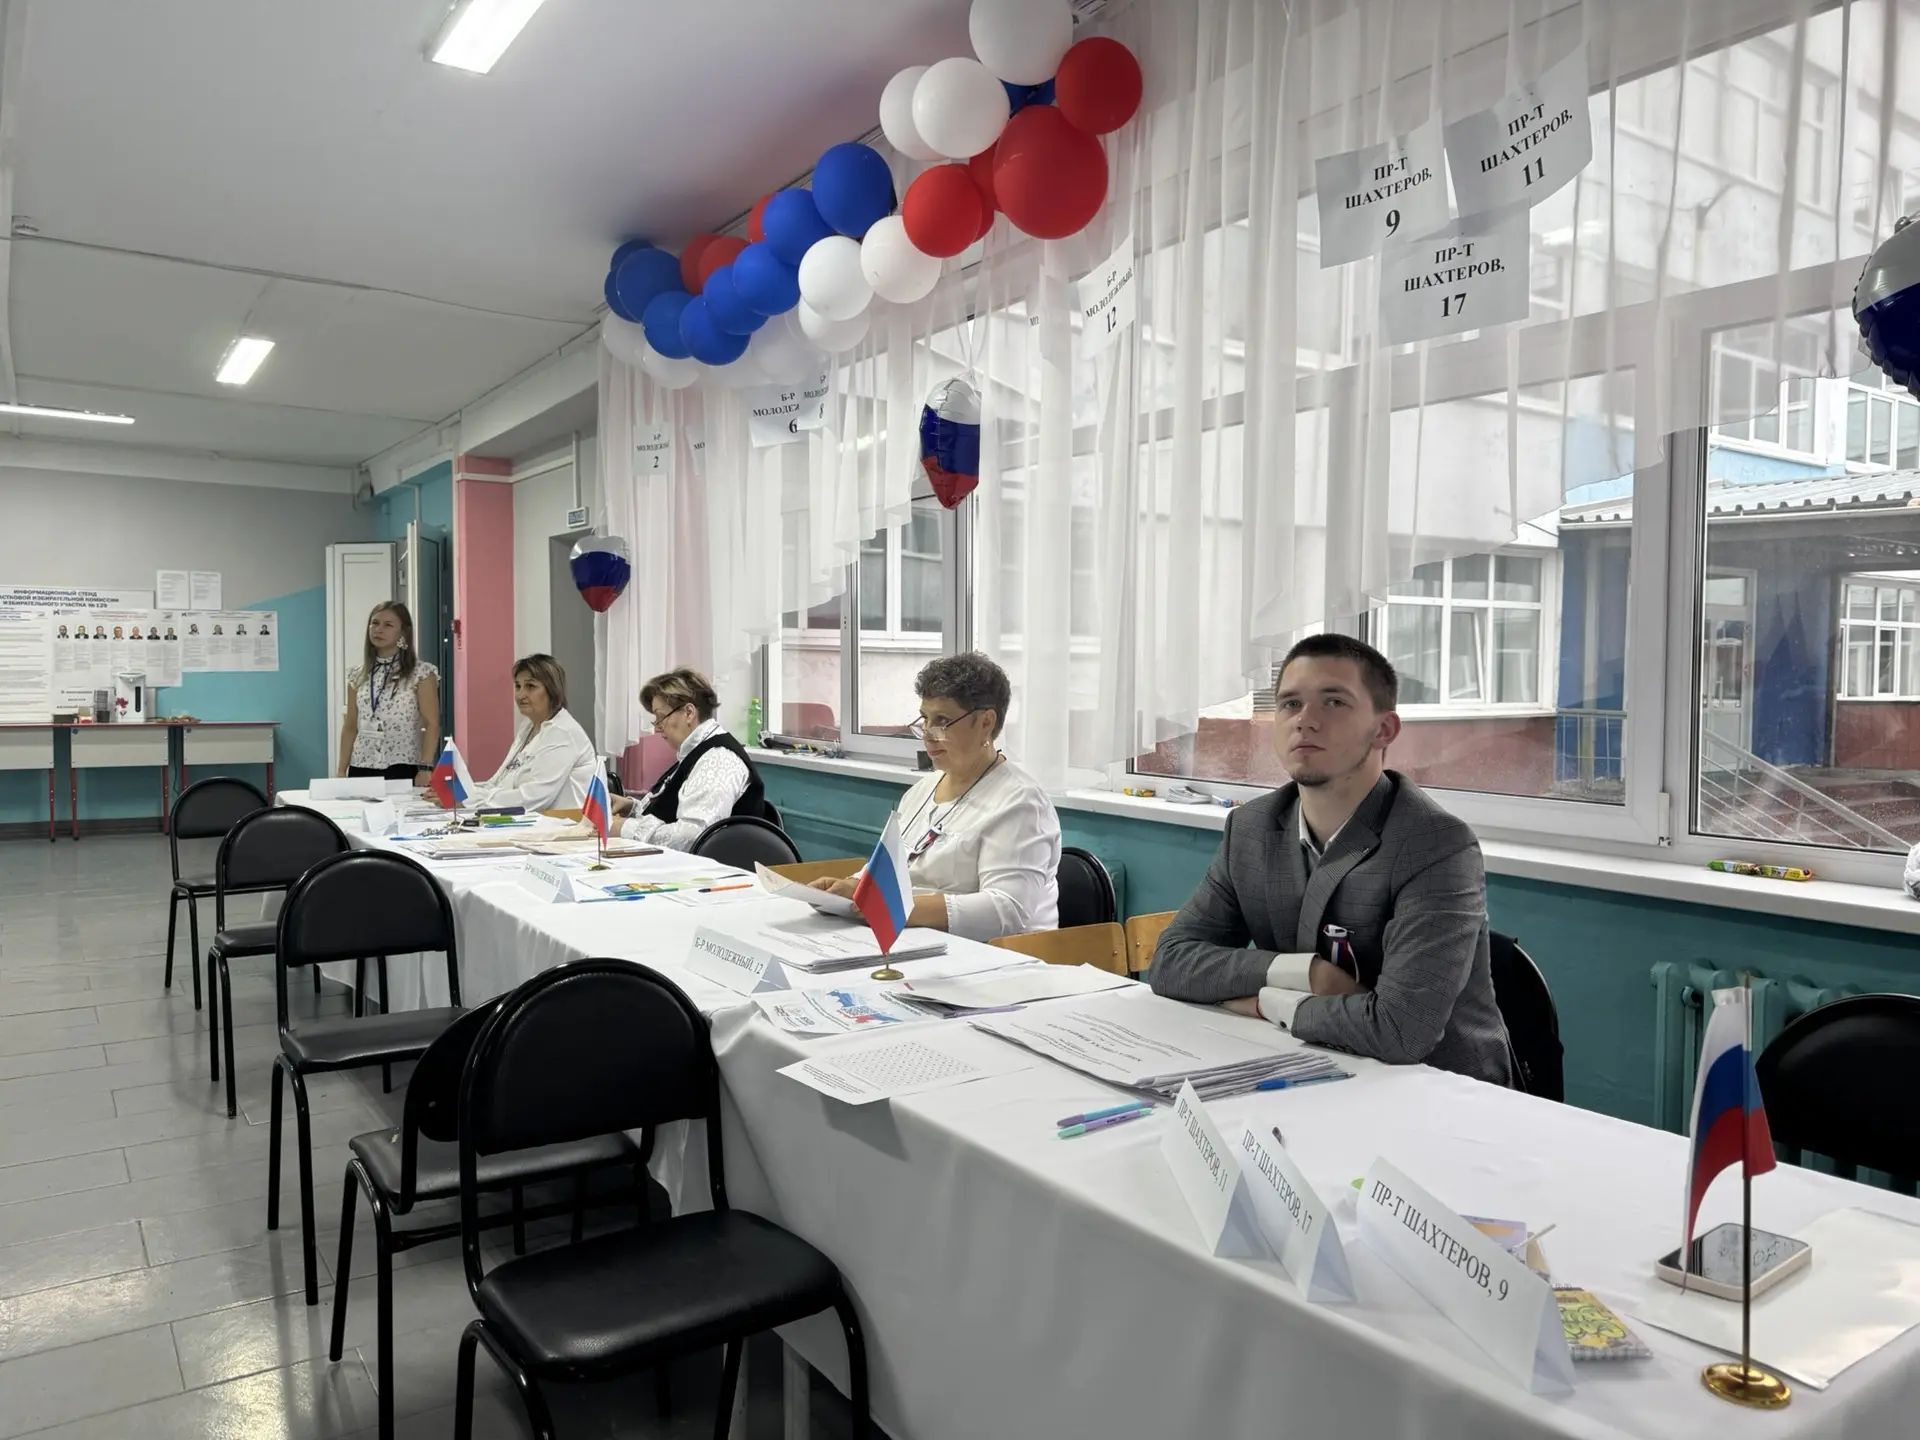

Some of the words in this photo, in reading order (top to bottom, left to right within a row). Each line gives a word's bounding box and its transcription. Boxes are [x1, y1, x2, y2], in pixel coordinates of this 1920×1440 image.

[1507, 104, 1545, 136] ПР-Т
[1374, 157, 1408, 180] ПР-Т
[1522, 157, 1546, 187] 11
[1345, 167, 1432, 209] ШАХТЕРОВ,
[1385, 209, 1401, 238] 9
[1434, 243, 1475, 264] ПР-Т
[1404, 258, 1506, 292] ШАХТЕРОВ,
[1107, 305, 1117, 332] 12
[1440, 293, 1467, 318] 17
[780, 392, 796, 402] Б-Р
[788, 418, 798, 434] 6
[653, 455, 660, 468] 2
[1177, 1098, 1193, 1127] ПР-Т
[1188, 1116, 1221, 1182] ШАХТЕРОВ,
[1218, 1168, 1228, 1192] 11
[1242, 1129, 1261, 1160] ПР-Т
[1257, 1149, 1302, 1226] ШАХТЕРОВ,
[1301, 1209, 1313, 1235] 17
[1371, 1180, 1405, 1216] ПР-Т
[1402, 1204, 1493, 1298] ШАХТЕРОВ,
[1497, 1278, 1509, 1301] 9
